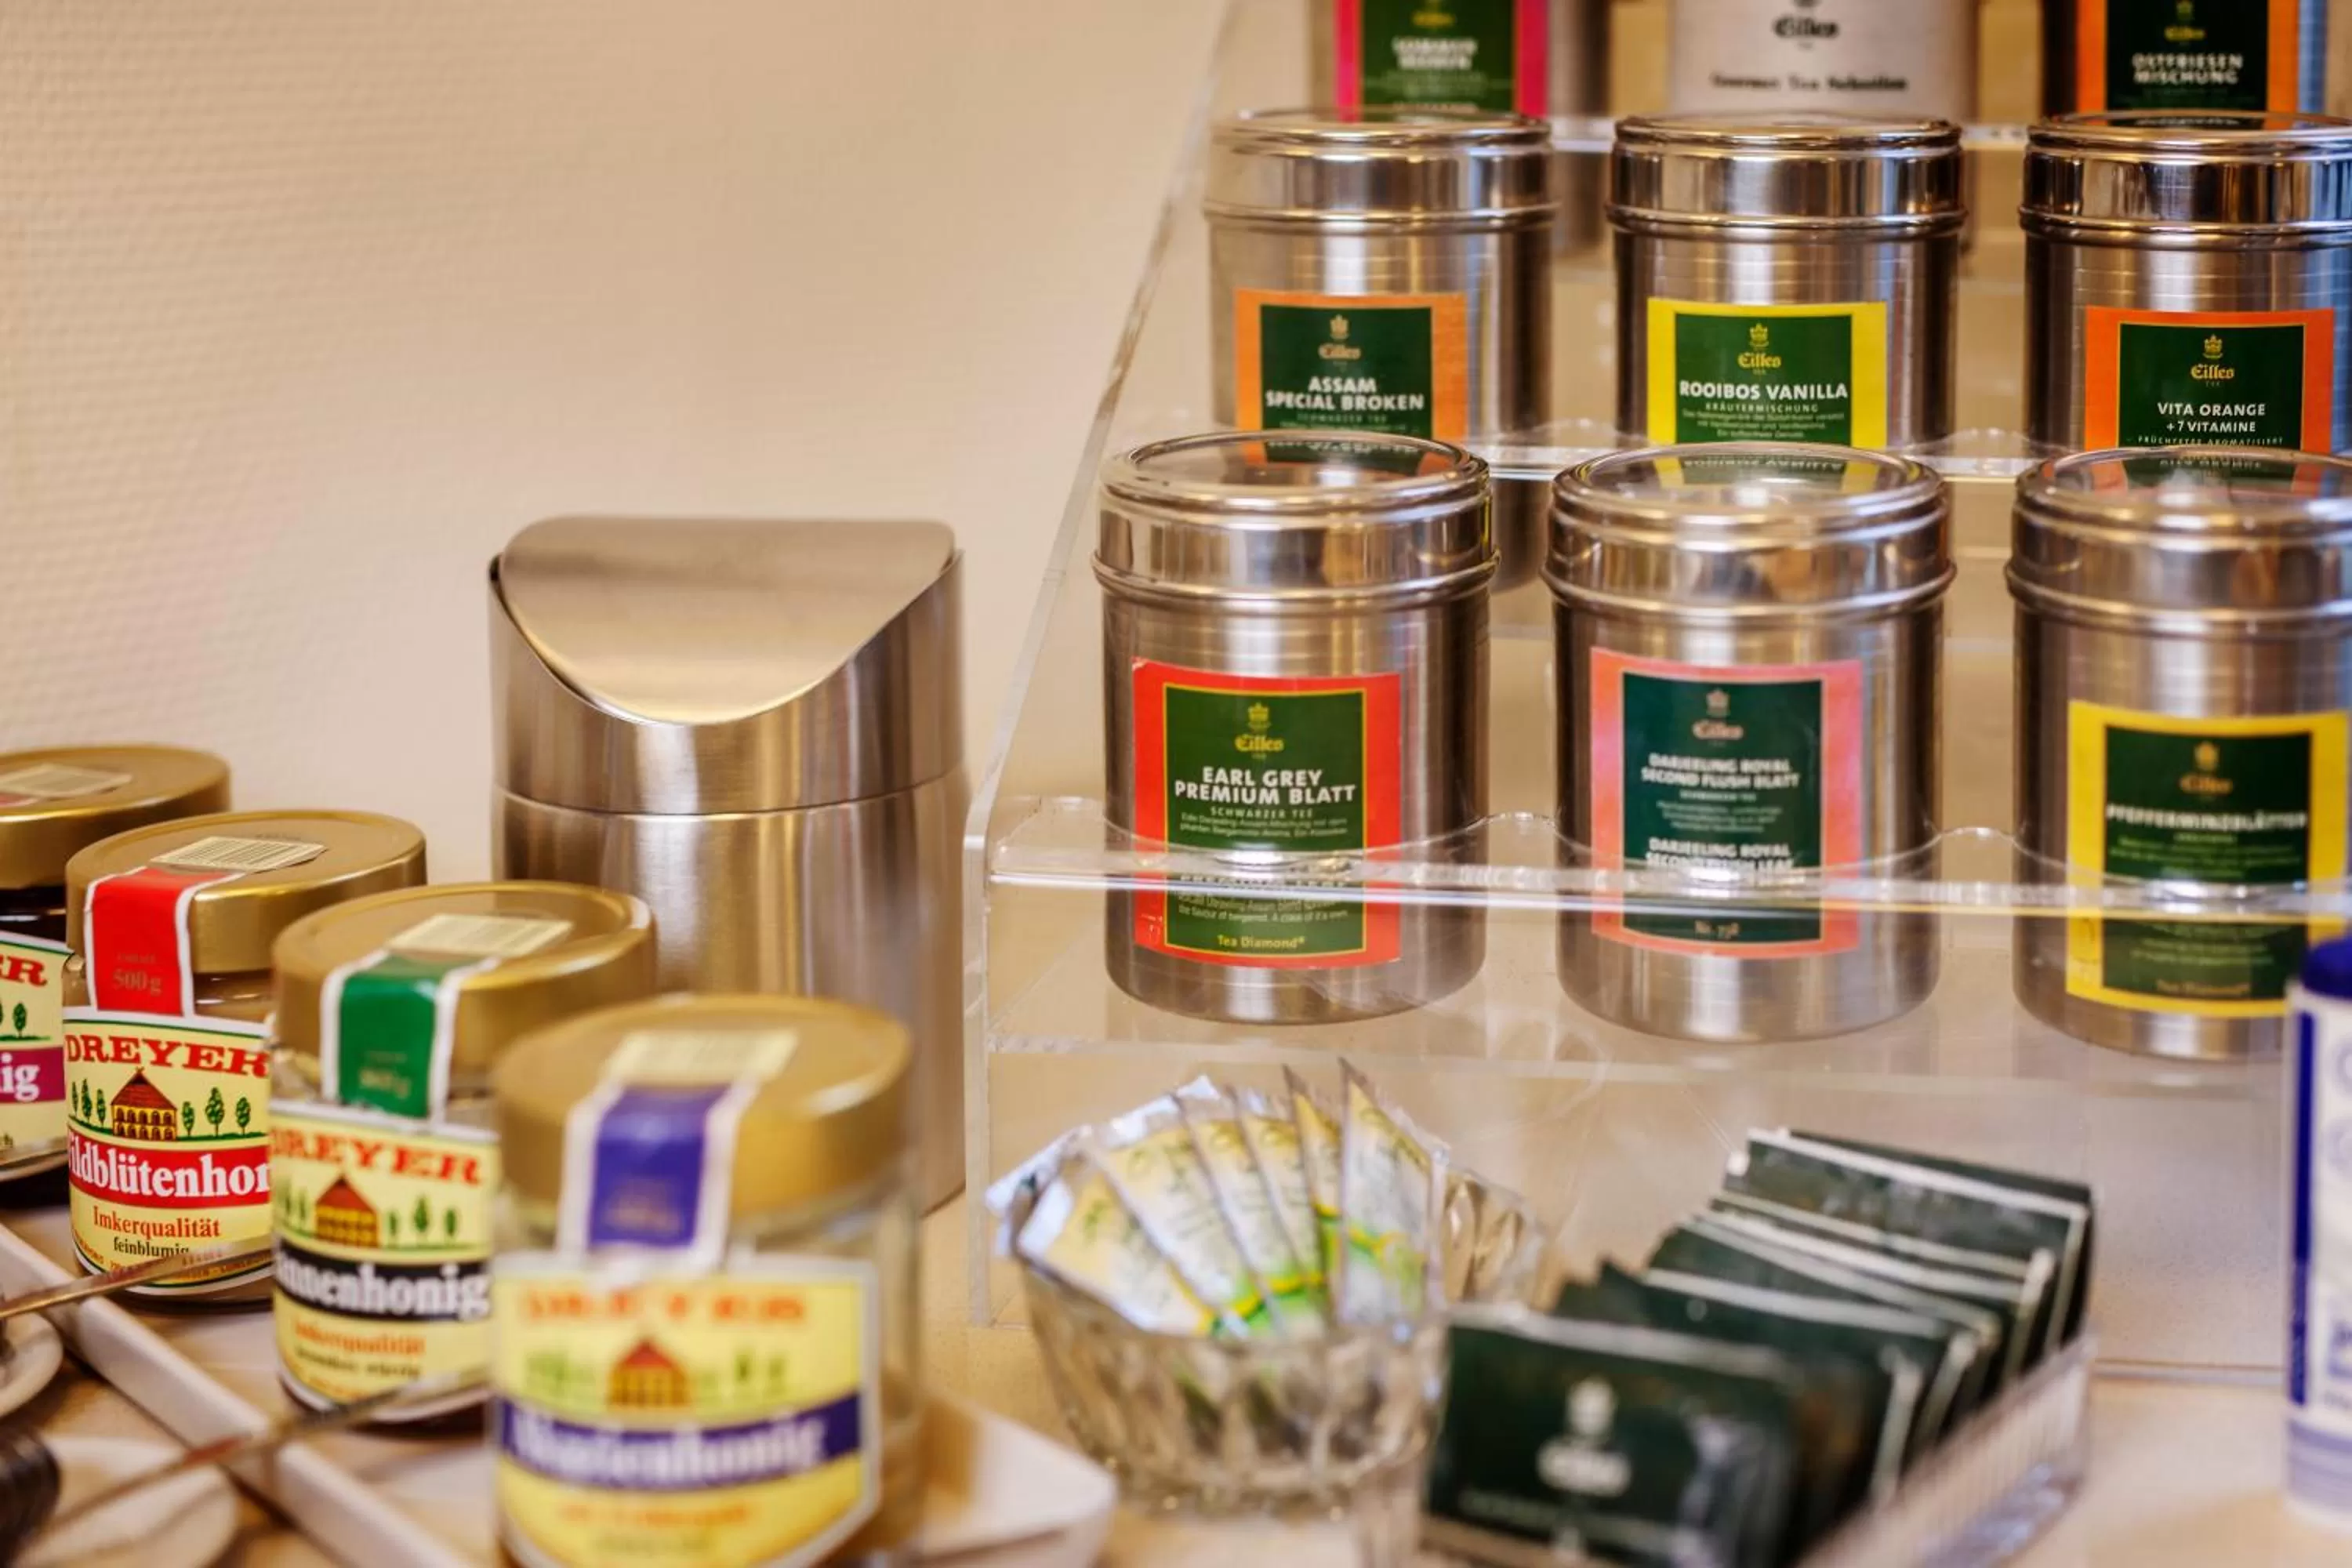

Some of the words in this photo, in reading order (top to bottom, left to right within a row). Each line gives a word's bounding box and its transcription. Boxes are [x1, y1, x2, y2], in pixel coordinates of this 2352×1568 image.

[1737, 352, 1782, 368] Eilles
[2190, 363, 2234, 380] Eilles
[1308, 376, 1377, 393] ASSAM
[1679, 380, 1760, 401] ROOIBOS
[1766, 383, 1848, 401] VANILLA
[1265, 390, 1335, 409] SPECIAL
[1341, 394, 1425, 411] BROKEN
[1705, 402, 1819, 413] KRÄUTERMISCHUNG
[2158, 402, 2194, 416] VITA
[2199, 403, 2266, 416] ORANGE
[2187, 421, 2256, 433] VITAMINE
[1203, 766, 1254, 786] EARL
[1261, 769, 1323, 787] GREY
[1174, 780, 1279, 805] PREMIUM
[1289, 785, 1356, 806] BLATT
[1210, 806, 1285, 819] SCHWARZER
[1292, 808, 1313, 818] TEE
[1218, 935, 1236, 946] Tea
[66, 1035, 269, 1078] DREYER
[93, 1206, 220, 1241] Imkerqualität
